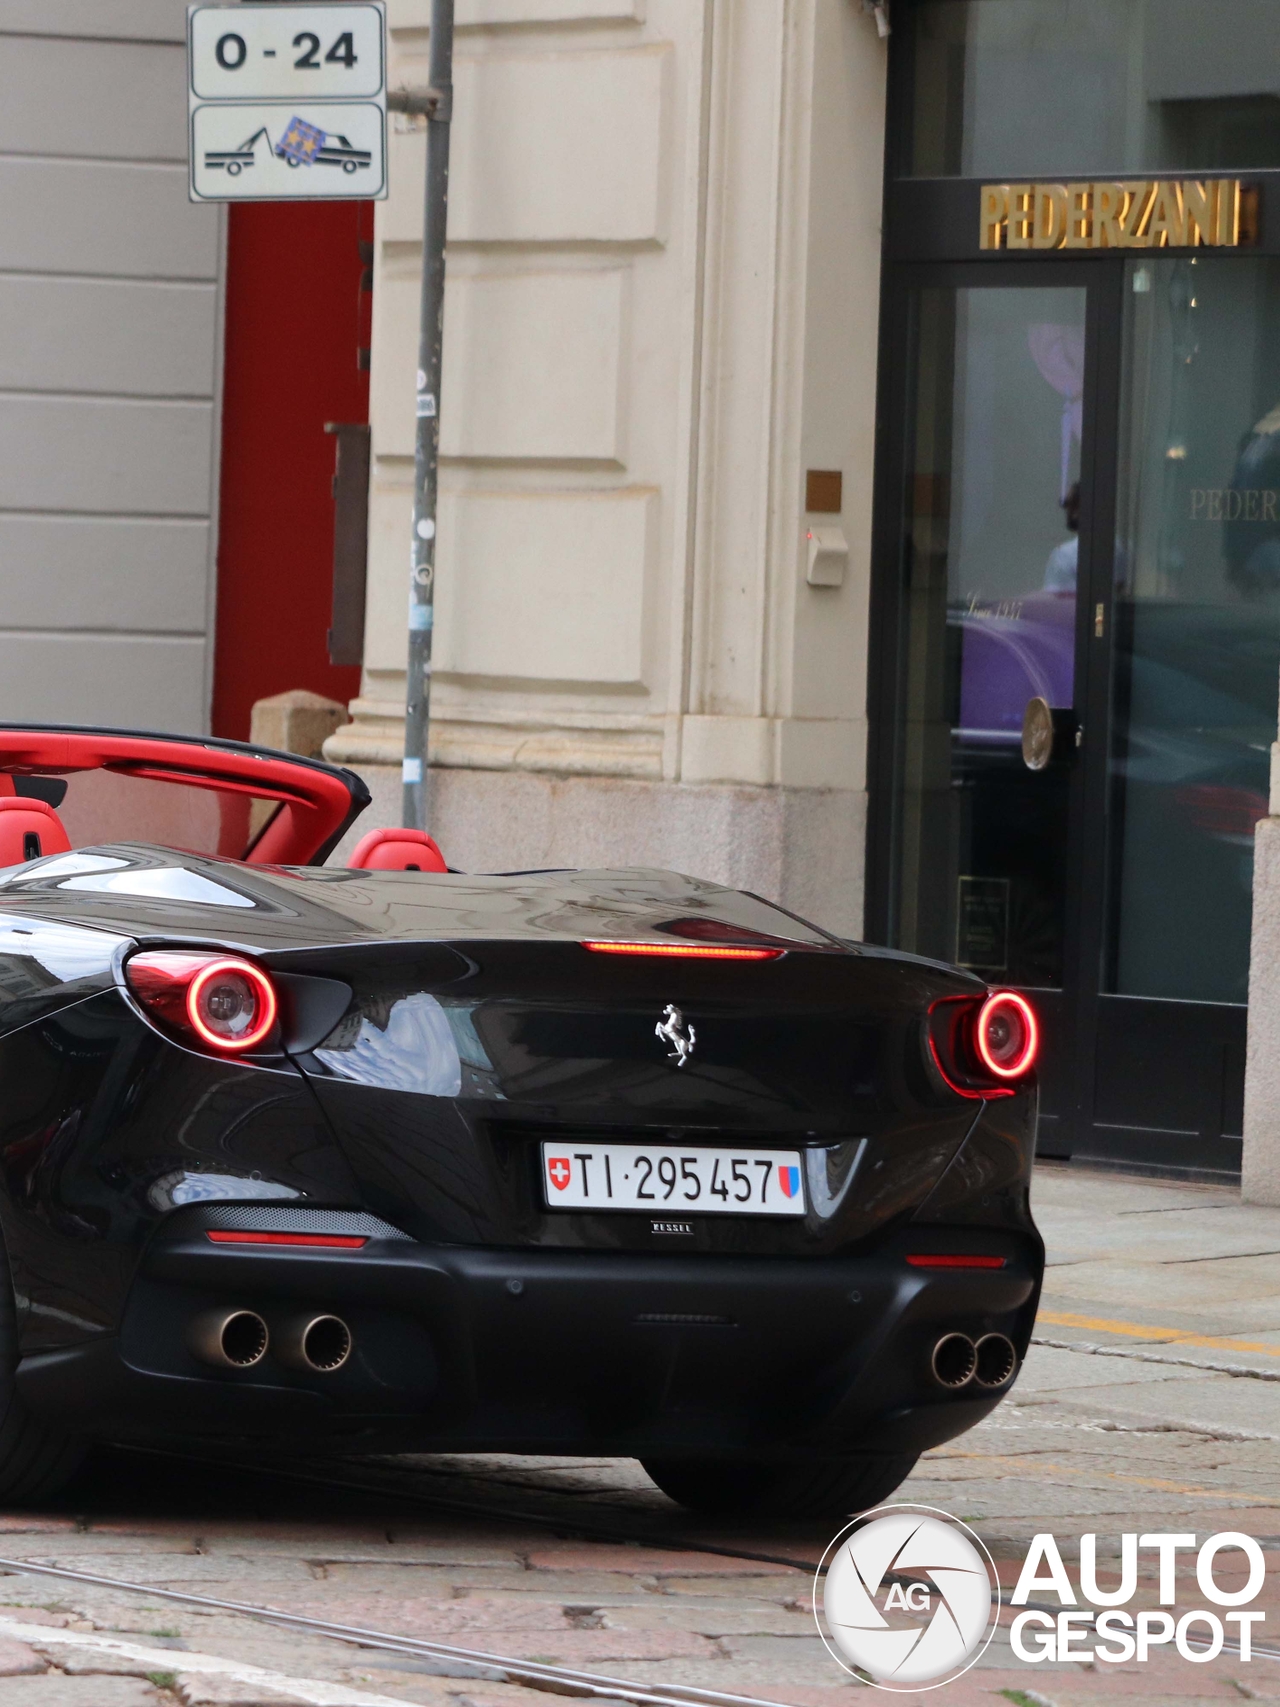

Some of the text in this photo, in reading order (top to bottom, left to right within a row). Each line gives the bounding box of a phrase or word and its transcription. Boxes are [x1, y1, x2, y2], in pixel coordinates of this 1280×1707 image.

[215, 33, 247, 71] 0
[292, 32, 359, 70] 24
[979, 179, 1241, 250] PEDERZANI
